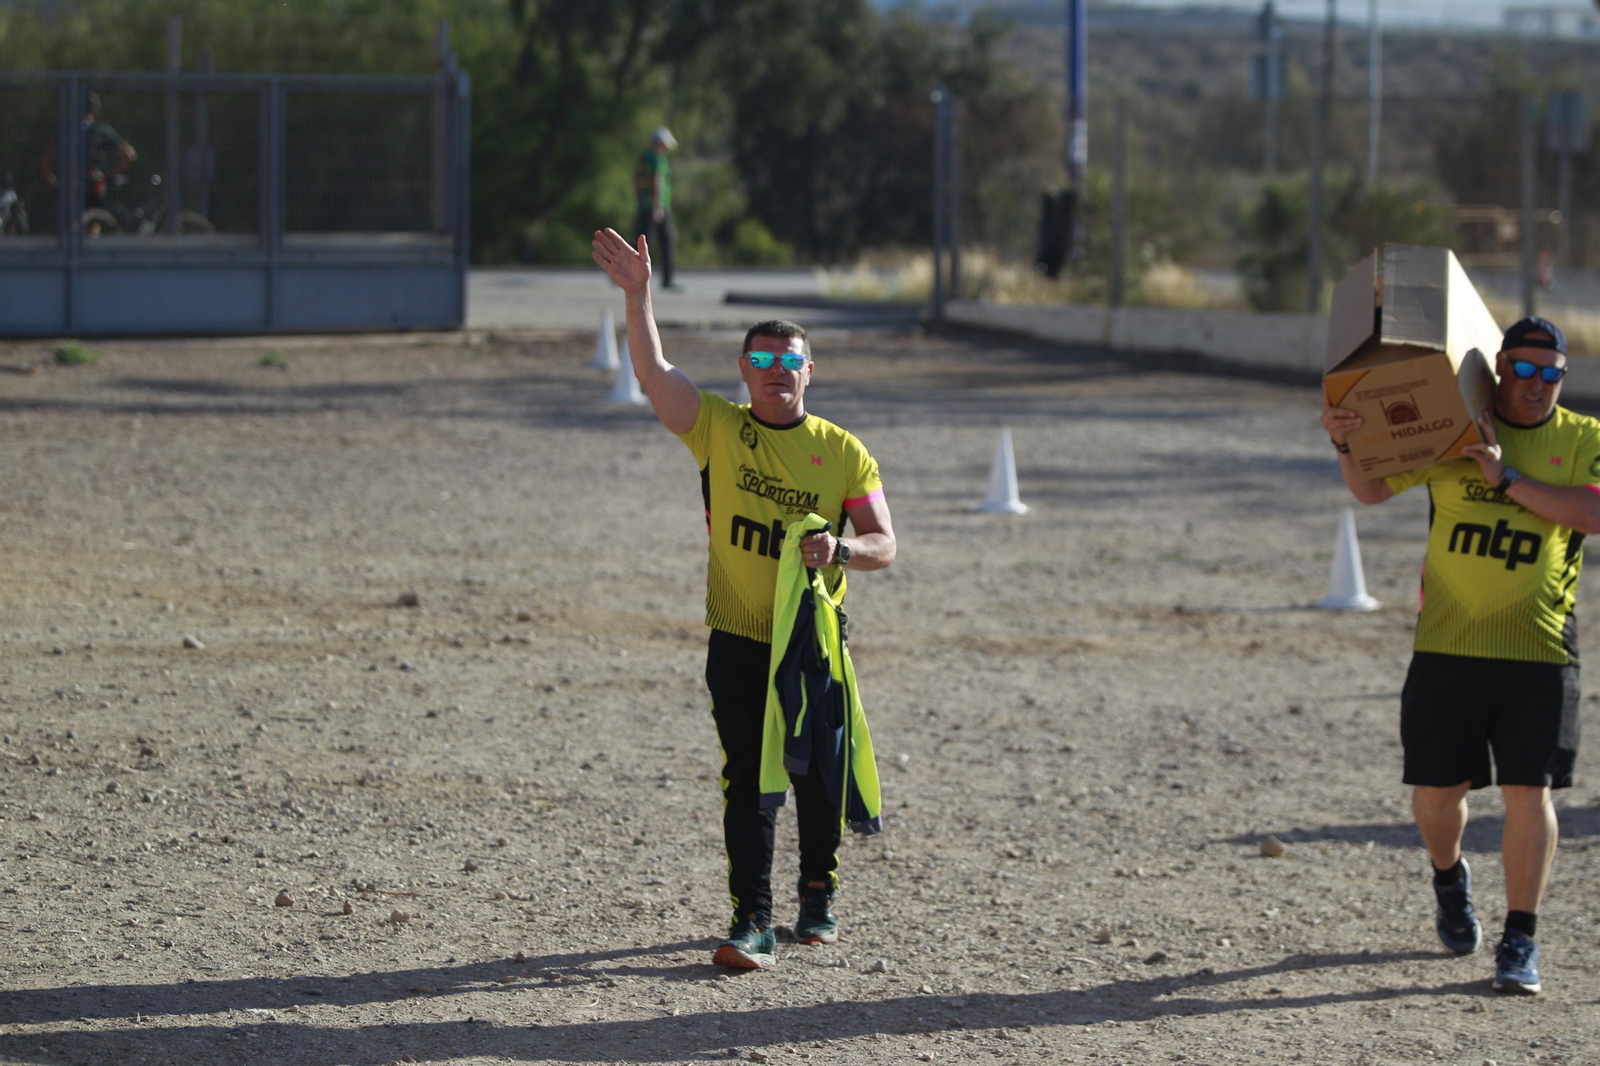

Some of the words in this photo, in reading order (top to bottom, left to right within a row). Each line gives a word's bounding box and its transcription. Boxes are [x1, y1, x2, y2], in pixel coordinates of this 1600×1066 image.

[1391, 417, 1454, 440] HIDALGO
[743, 472, 819, 508] SPORTGYM
[731, 514, 786, 560] mt
[1448, 518, 1542, 571] mtp
